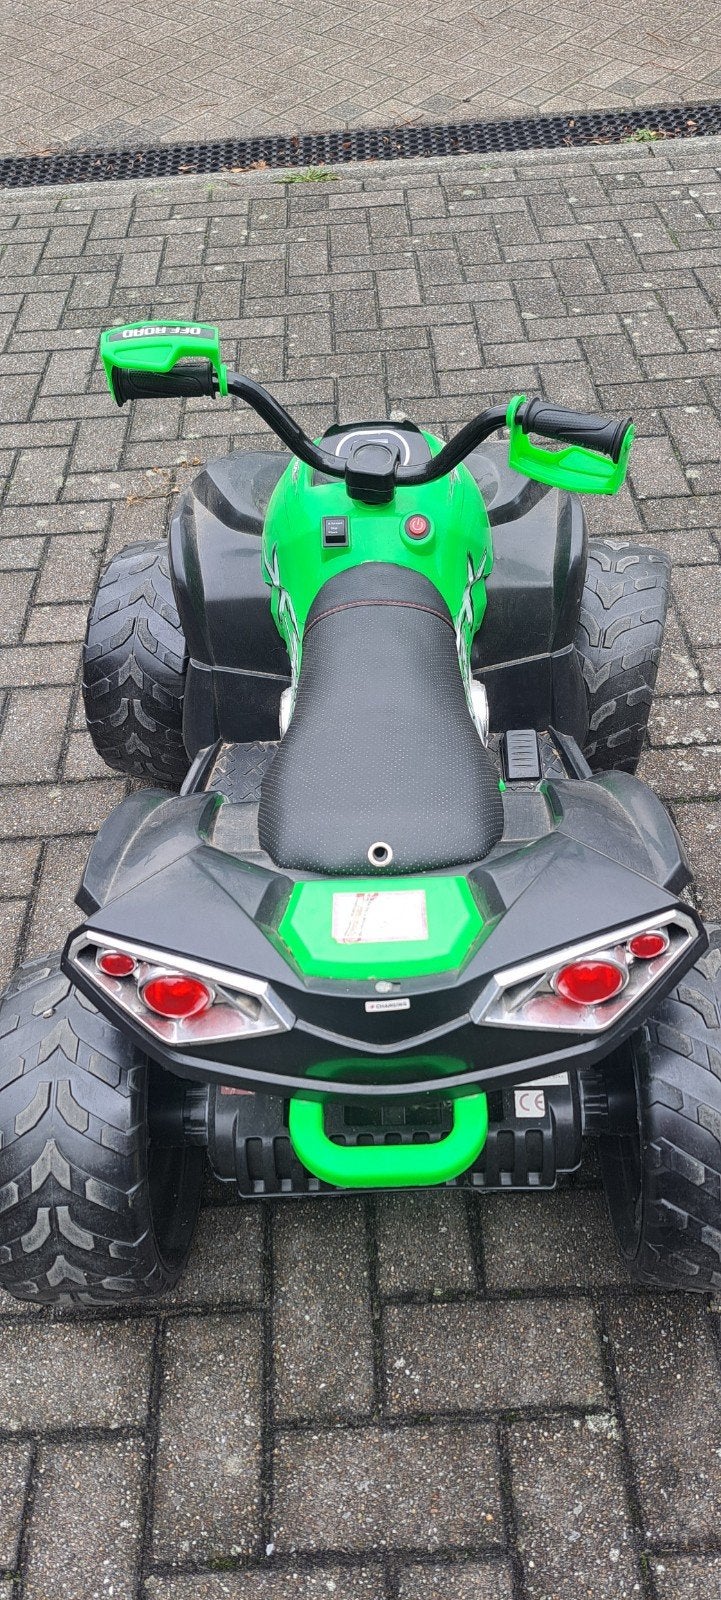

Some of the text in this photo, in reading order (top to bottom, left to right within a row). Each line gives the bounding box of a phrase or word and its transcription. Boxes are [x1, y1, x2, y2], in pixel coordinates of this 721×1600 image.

[122, 326, 202, 339] OFF ROAD
[518, 1093, 546, 1112] CE
